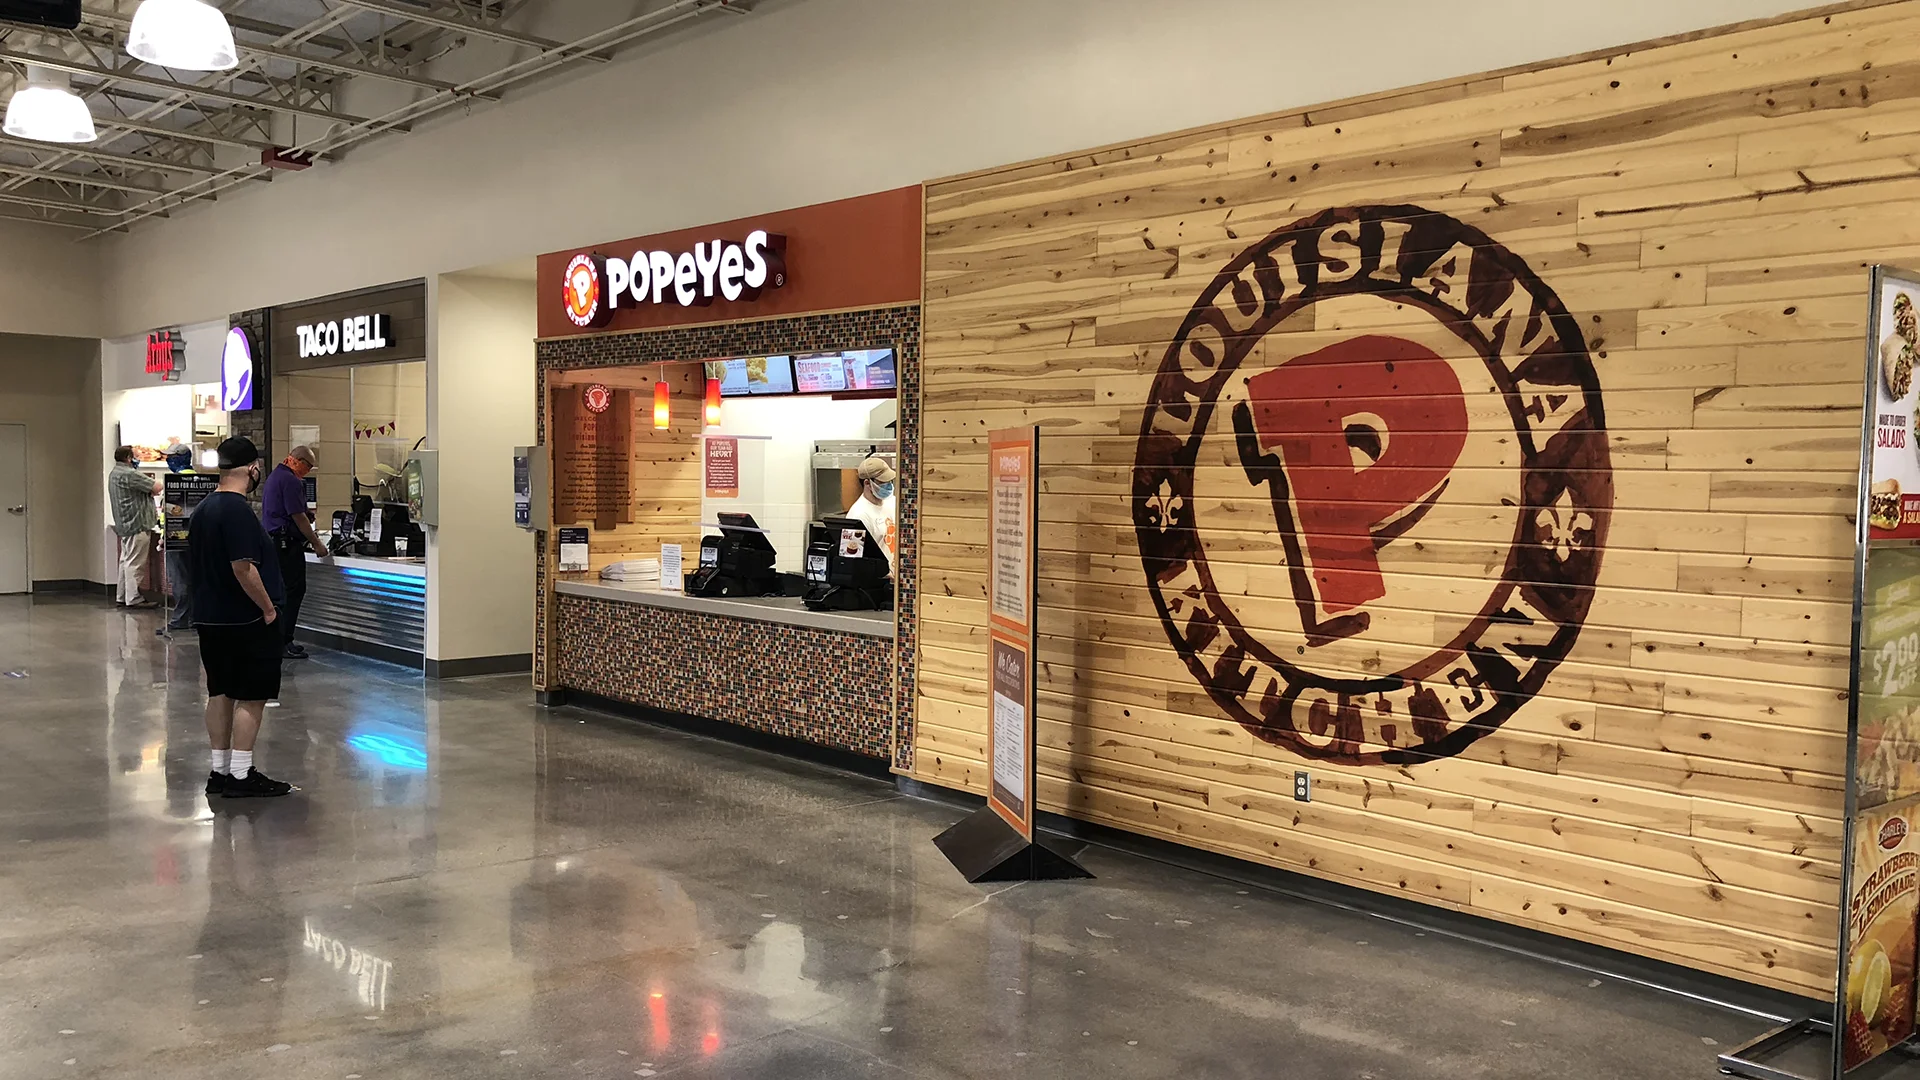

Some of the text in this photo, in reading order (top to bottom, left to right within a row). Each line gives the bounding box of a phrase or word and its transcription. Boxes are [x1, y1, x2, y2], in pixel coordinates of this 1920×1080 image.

[296, 313, 386, 358] TACO BELL
[1149, 221, 1586, 453] LOUISIANA
[1877, 427, 1906, 449] SALADS
[1907, 511, 1920, 524] SALA
[1157, 559, 1565, 756] KITCHEN
[1898, 666, 1918, 690] OFF
[1879, 821, 1907, 844] CHARLEYS
[1851, 851, 1920, 922] STRAWBERRY
[1858, 872, 1915, 939] LEMONADE
